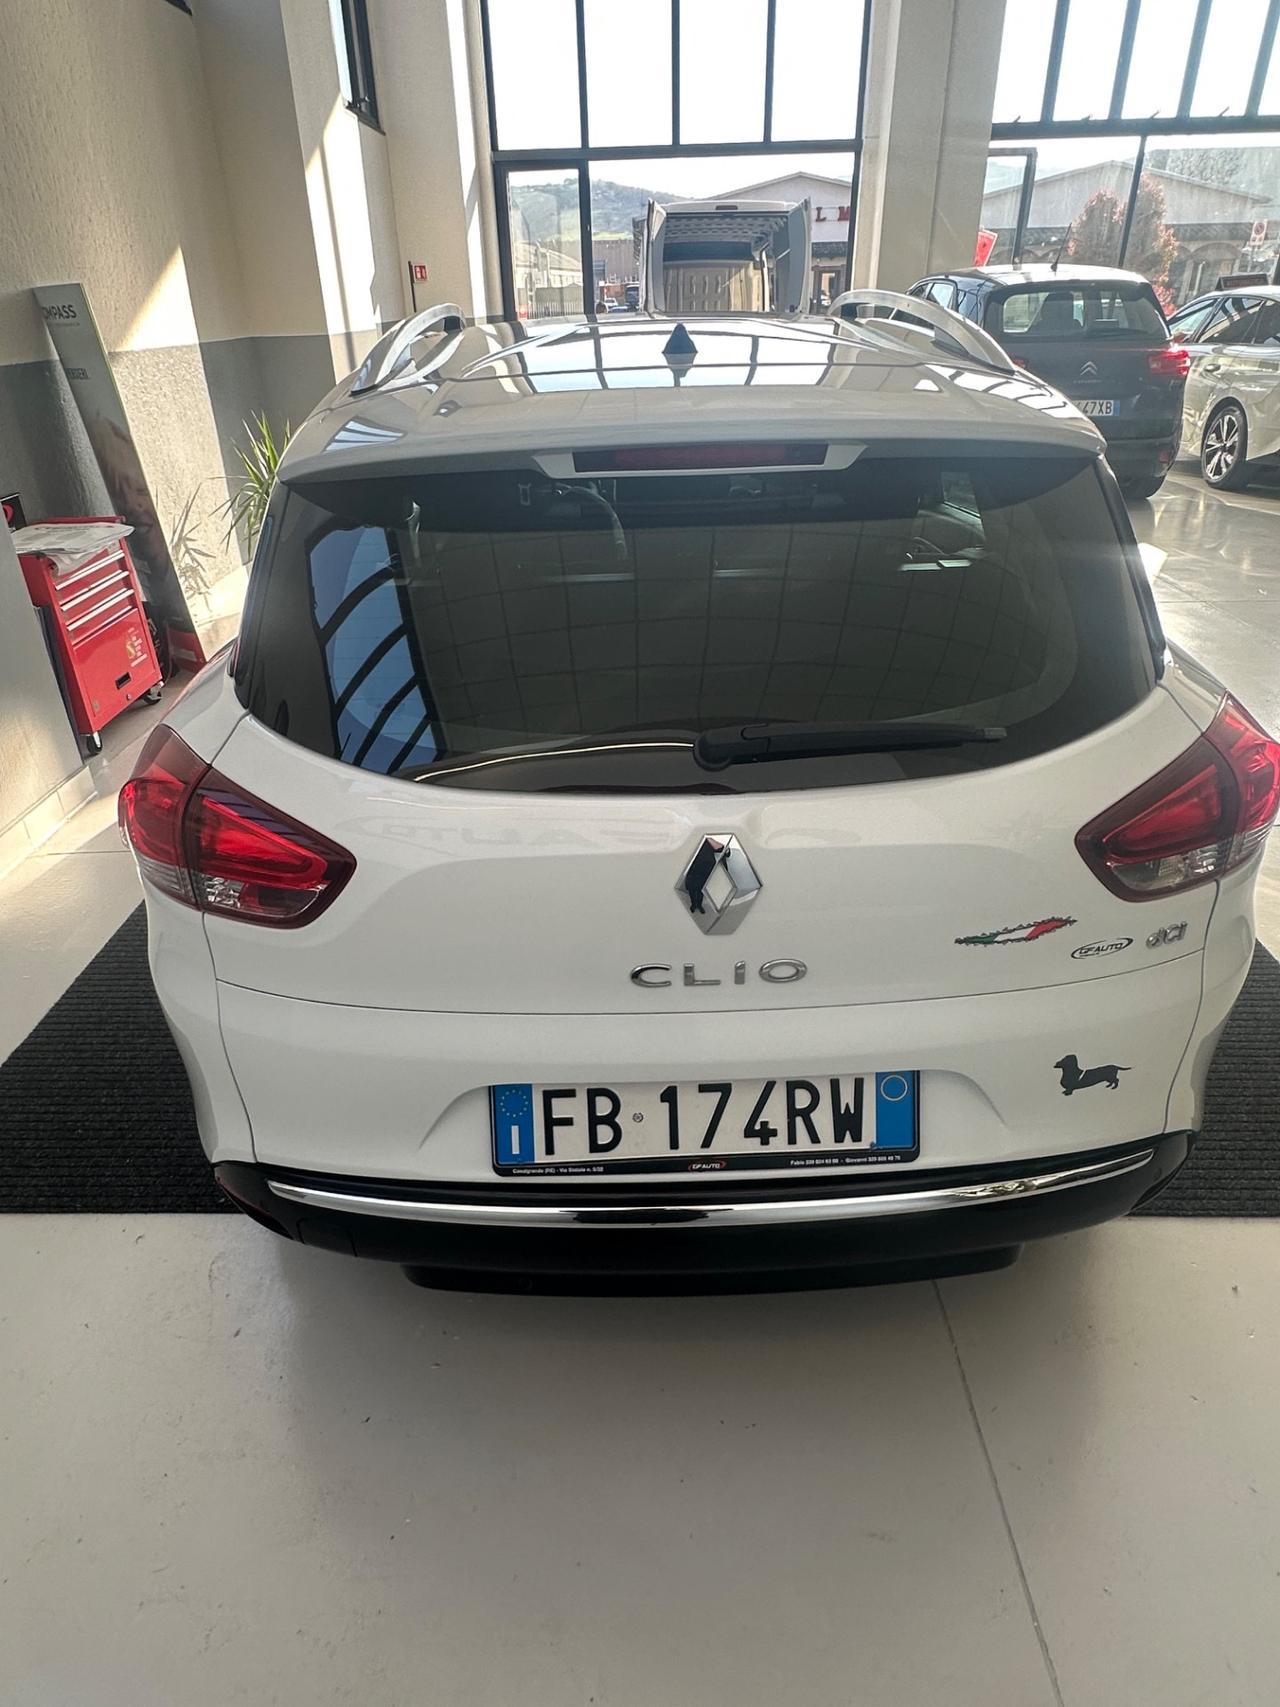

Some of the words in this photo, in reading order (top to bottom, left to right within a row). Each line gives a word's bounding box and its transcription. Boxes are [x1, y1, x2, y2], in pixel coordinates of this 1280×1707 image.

[630, 958, 808, 988] CLIO
[542, 1087, 623, 1156] FB
[660, 1077, 864, 1150] 174RW
